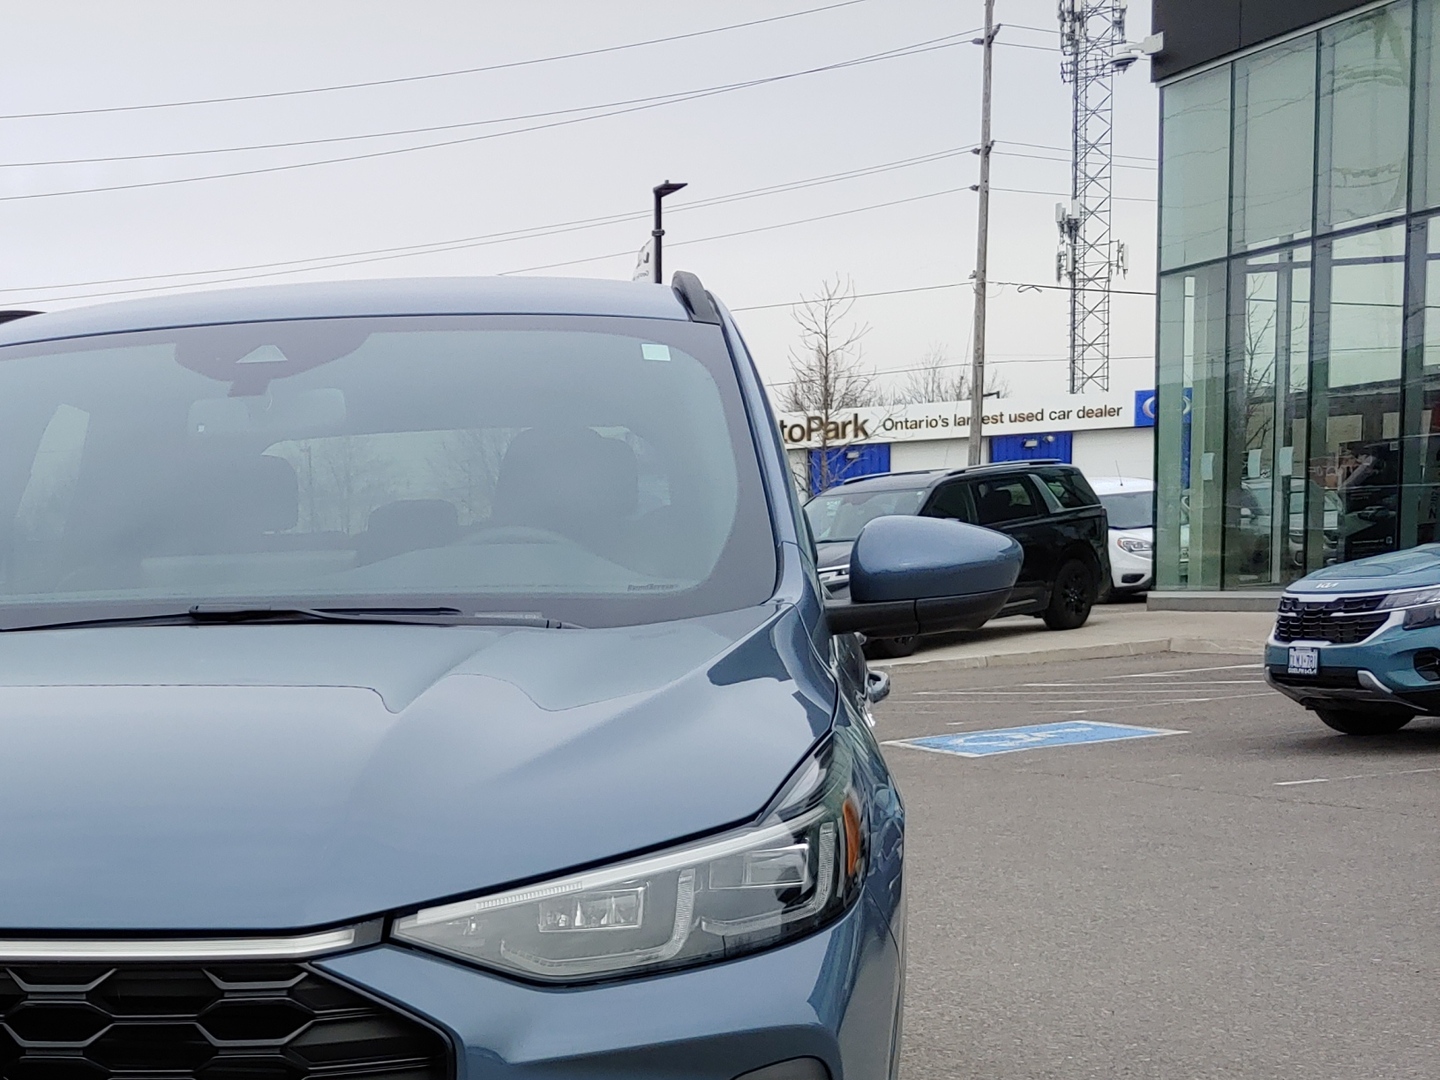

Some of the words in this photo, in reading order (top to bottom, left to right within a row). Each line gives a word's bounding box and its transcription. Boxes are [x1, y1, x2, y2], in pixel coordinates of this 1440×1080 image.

[882, 415, 949, 431] Ontario's
[954, 412, 1005, 427] larest
[1009, 408, 1044, 423] used
[1049, 408, 1072, 421] car
[1076, 404, 1123, 419] dealer
